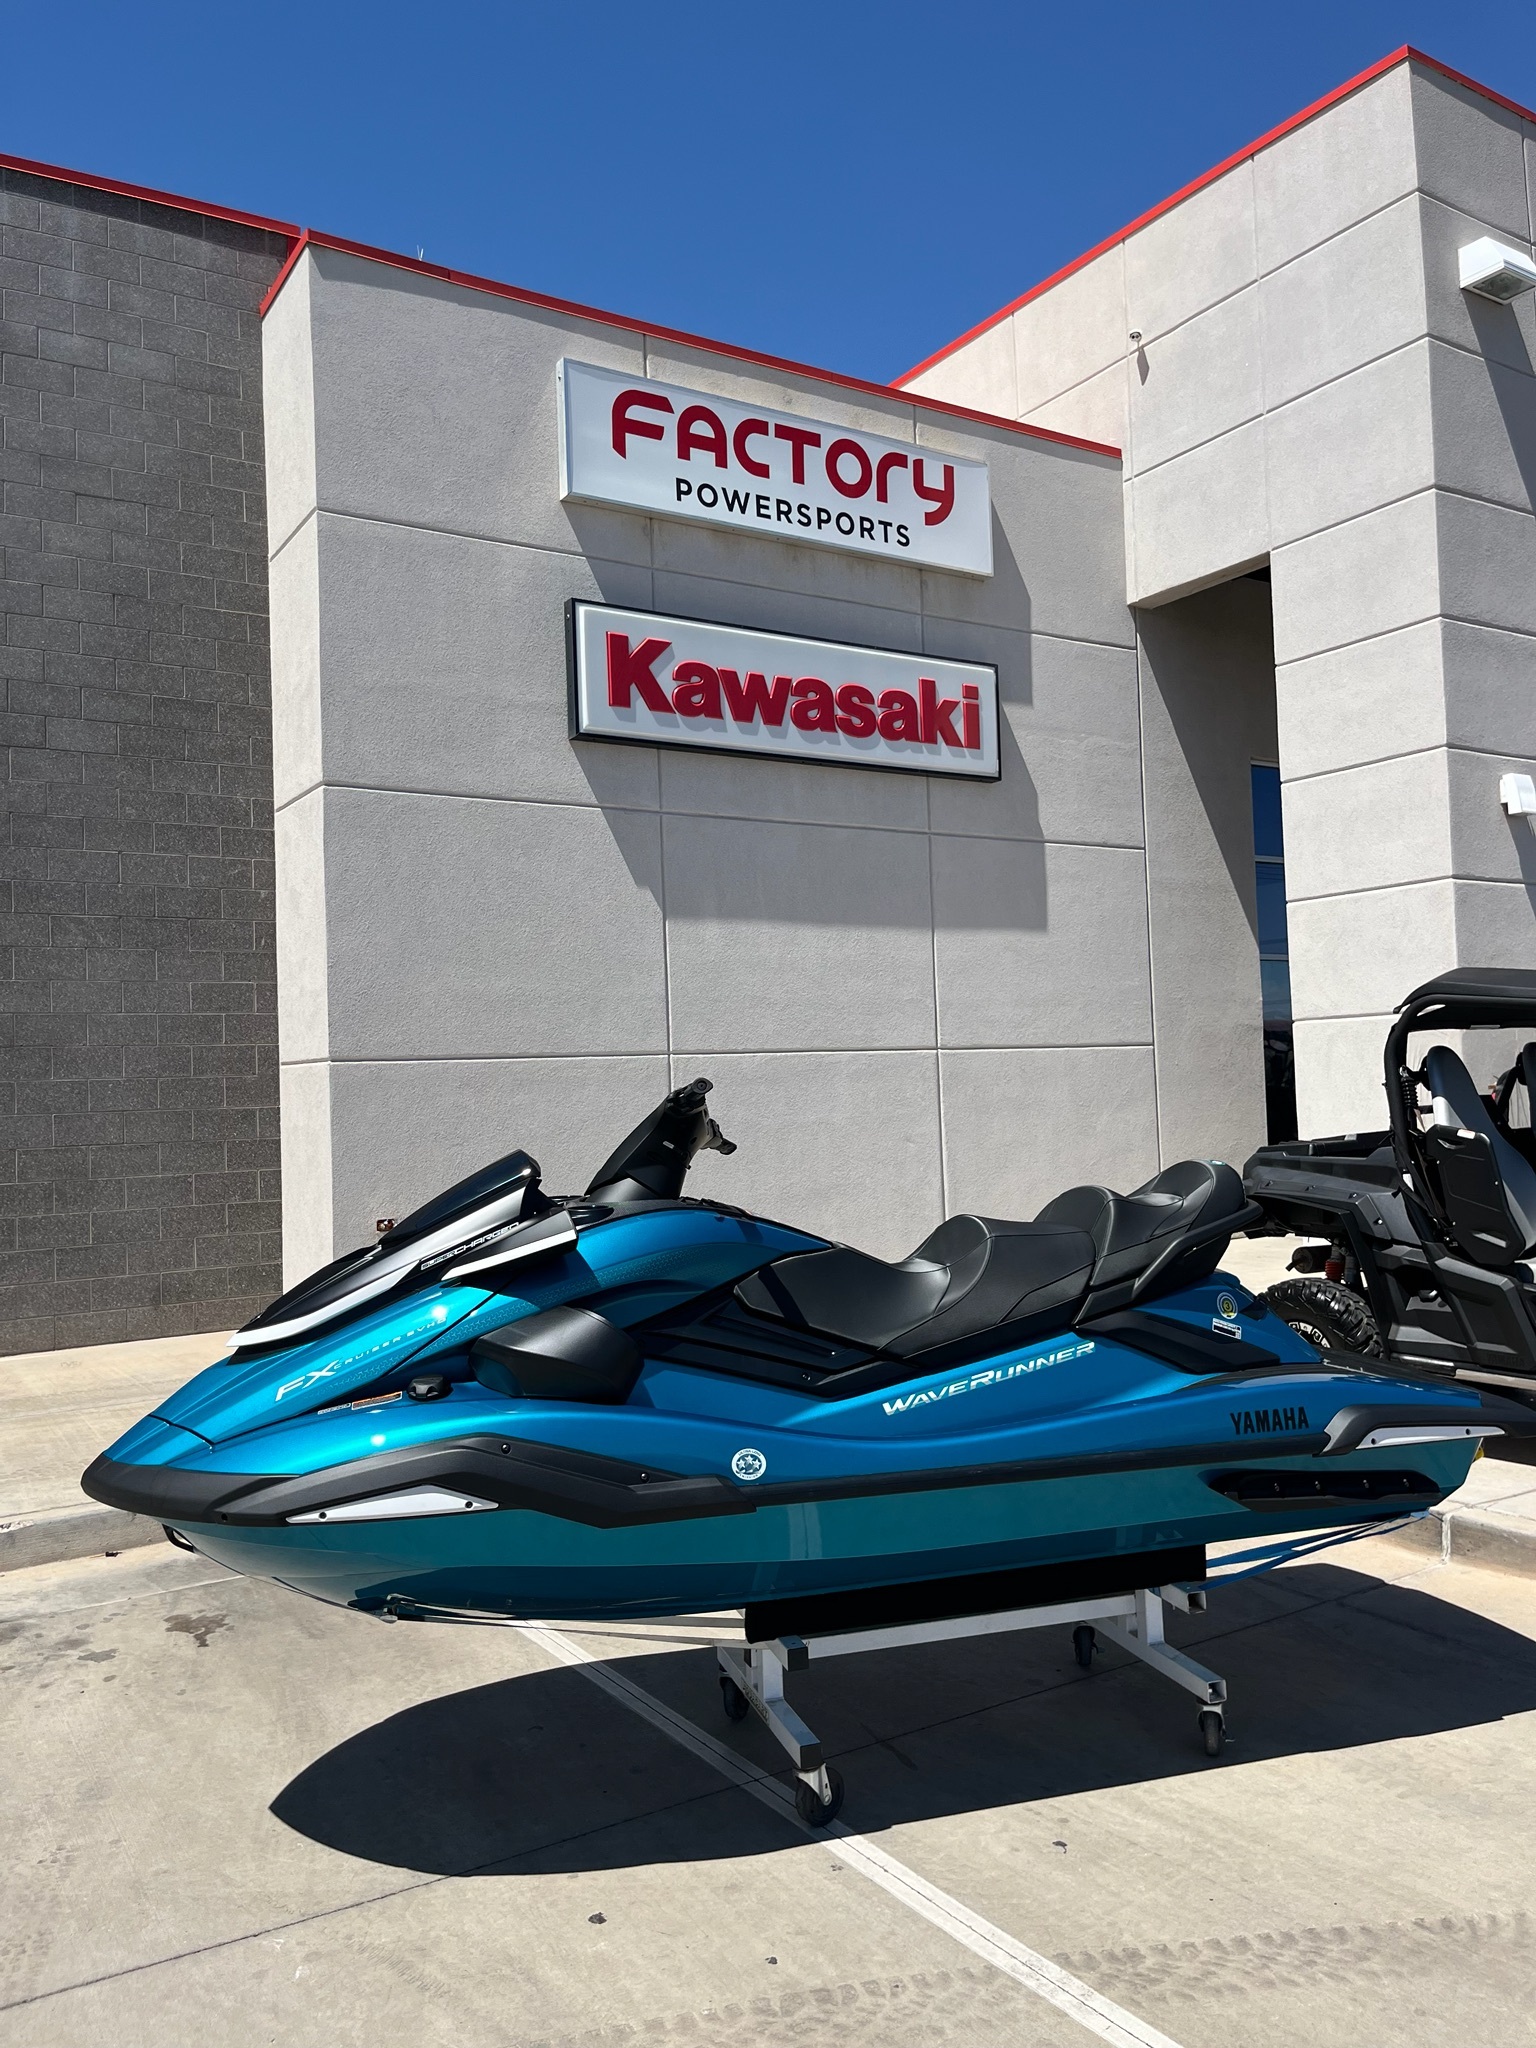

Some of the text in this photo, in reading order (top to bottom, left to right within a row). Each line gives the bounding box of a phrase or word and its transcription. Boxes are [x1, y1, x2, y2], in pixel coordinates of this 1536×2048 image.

[675, 477, 911, 547] POWERSPORTS
[605, 630, 982, 750] Kawasaki
[275, 1359, 339, 1402] FX
[882, 1340, 1096, 1417] WAVERUNNER
[1229, 1406, 1310, 1436] YAMAHA
